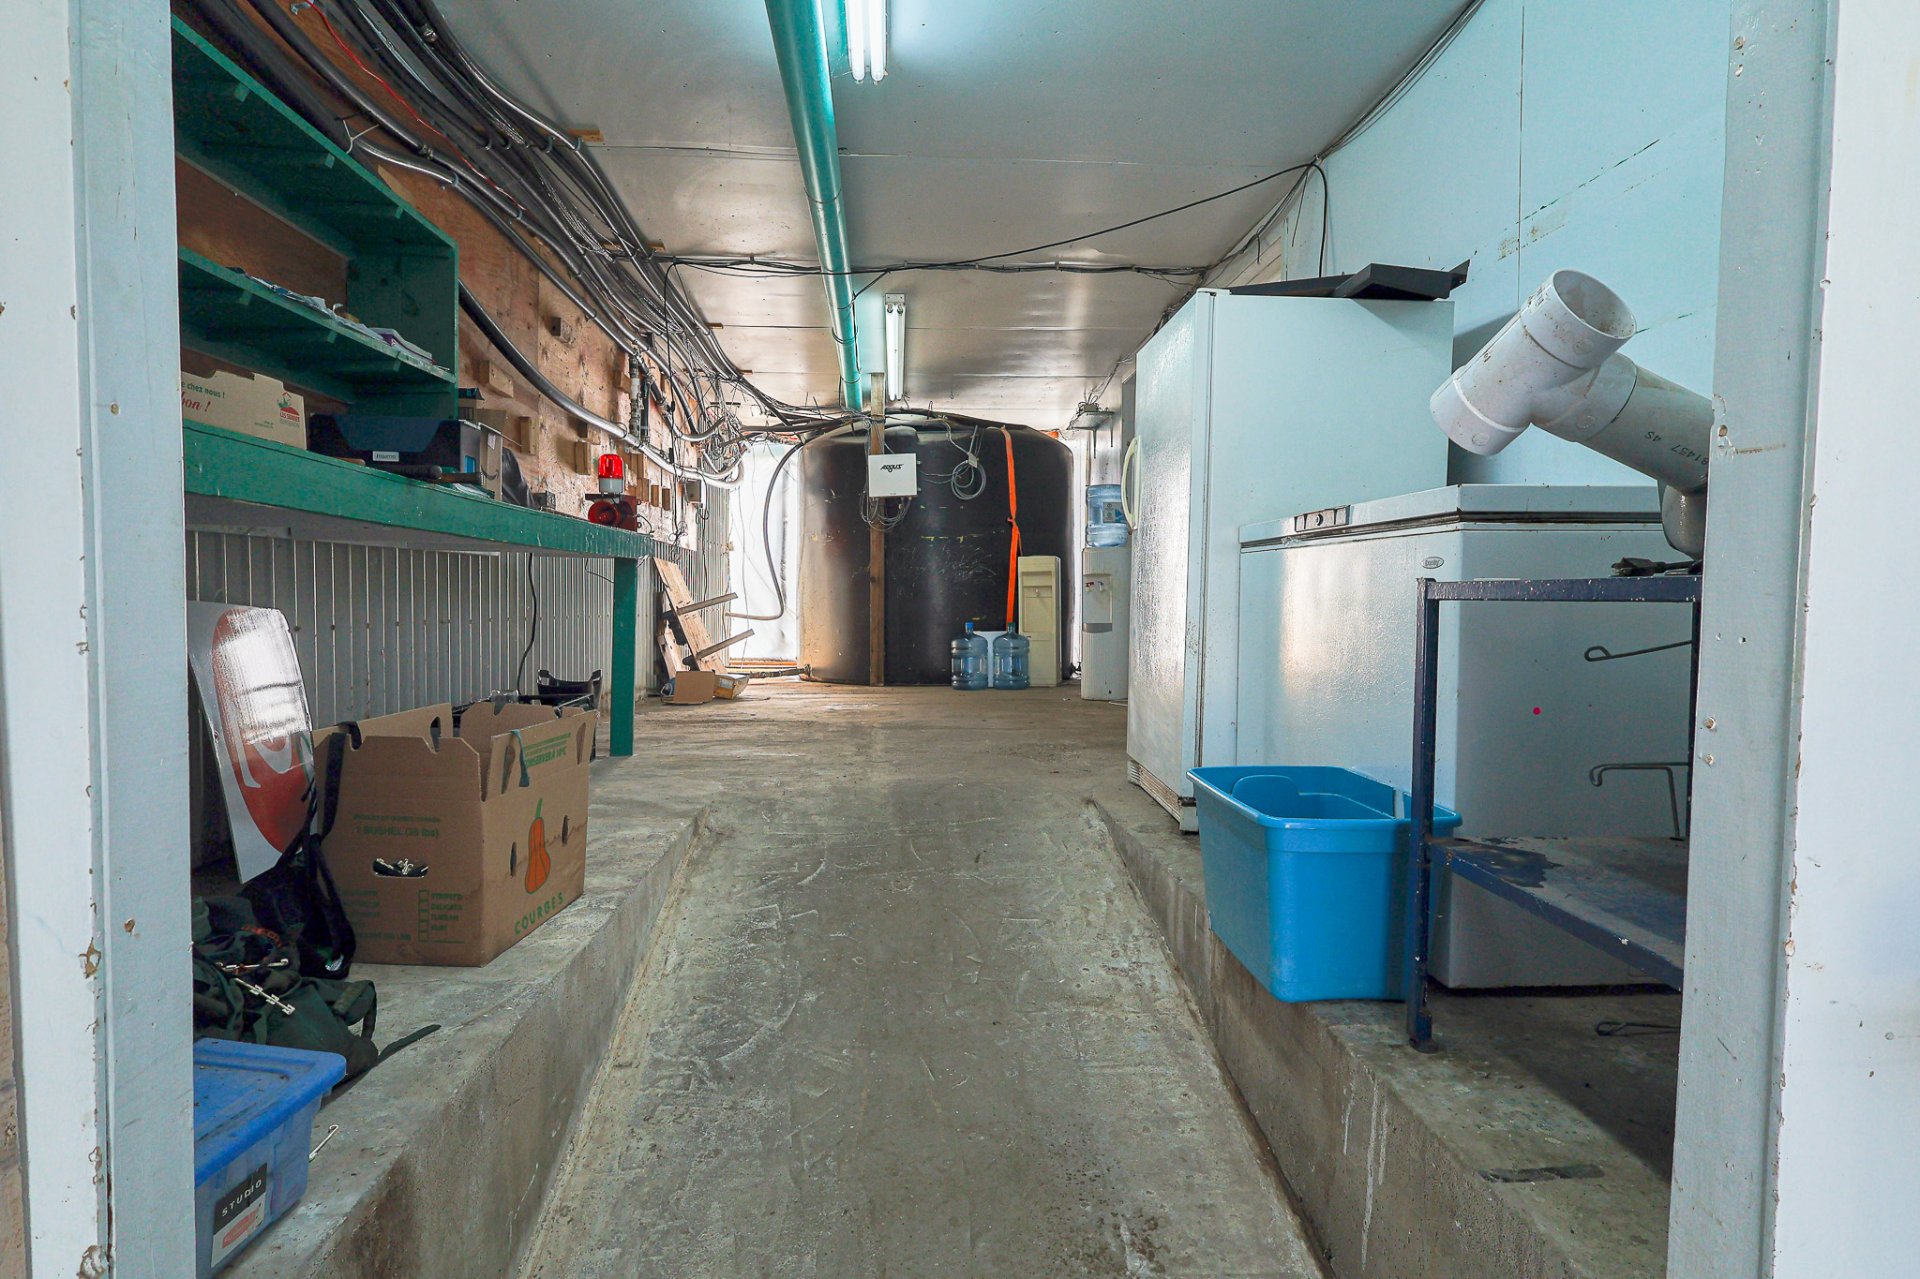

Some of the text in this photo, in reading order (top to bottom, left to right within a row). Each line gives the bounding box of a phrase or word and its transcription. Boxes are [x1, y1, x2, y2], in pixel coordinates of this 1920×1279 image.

[187, 383, 203, 393] chez
[205, 388, 221, 398] nous
[514, 890, 564, 936] COURGES
[222, 1179, 262, 1217] STUDIO
